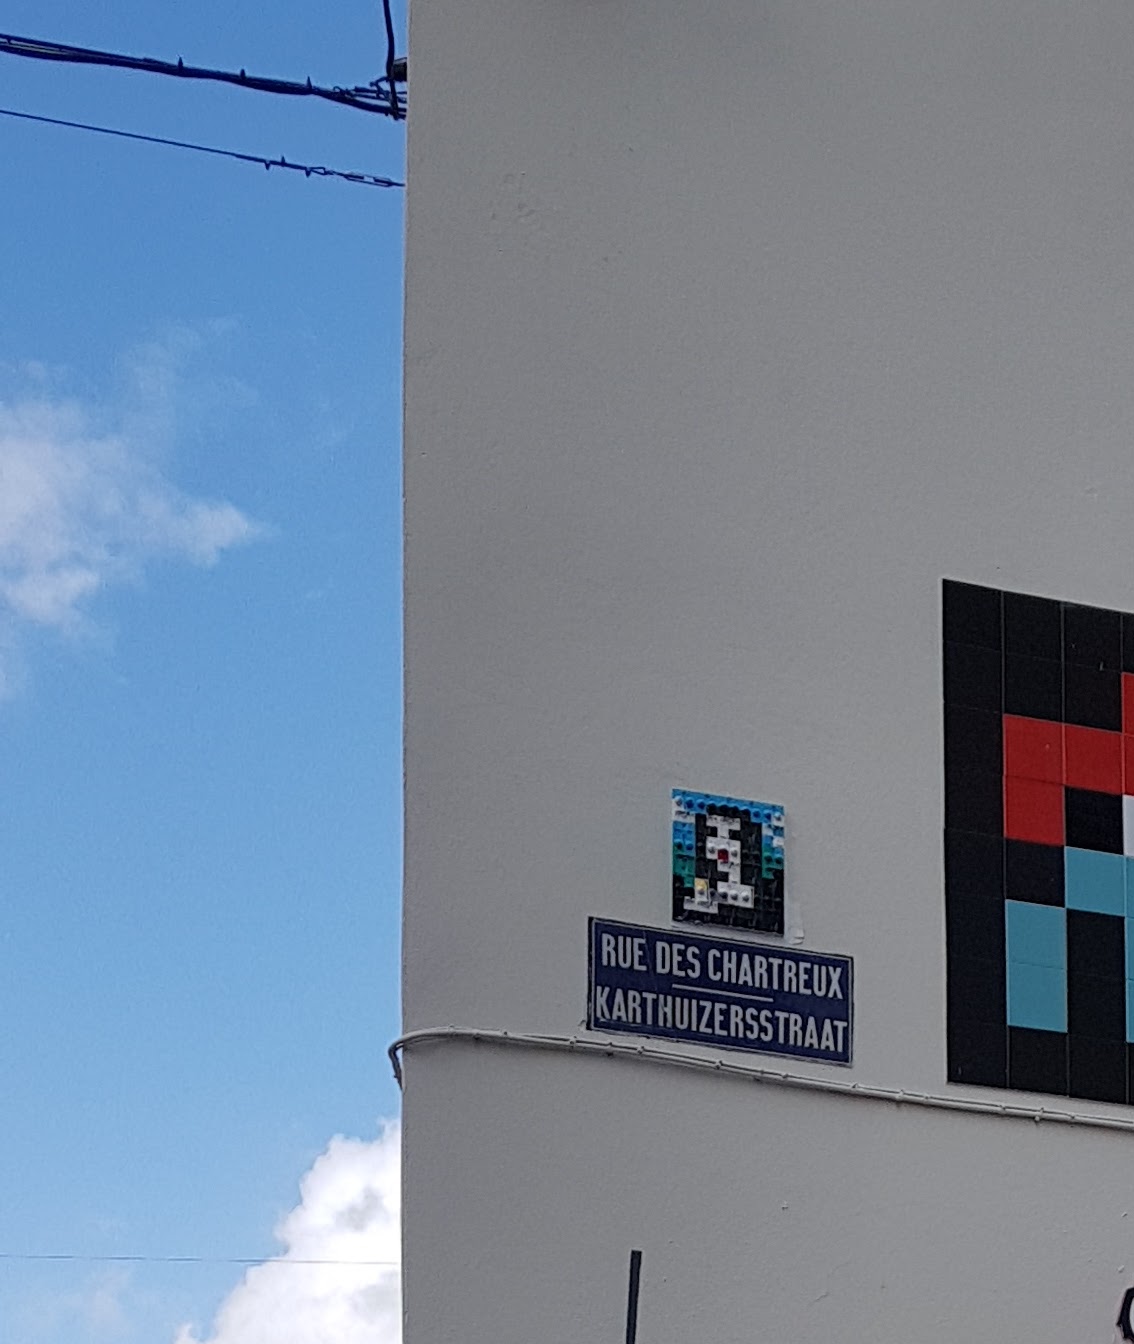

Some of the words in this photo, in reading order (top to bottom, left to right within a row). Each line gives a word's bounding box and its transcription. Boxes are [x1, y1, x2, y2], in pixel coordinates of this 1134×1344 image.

[601, 933, 648, 972] RUE
[655, 941, 701, 980] DES
[707, 948, 844, 1000] CHARTREUX
[595, 985, 848, 1053] KARTHUIZERSSTRAAT
